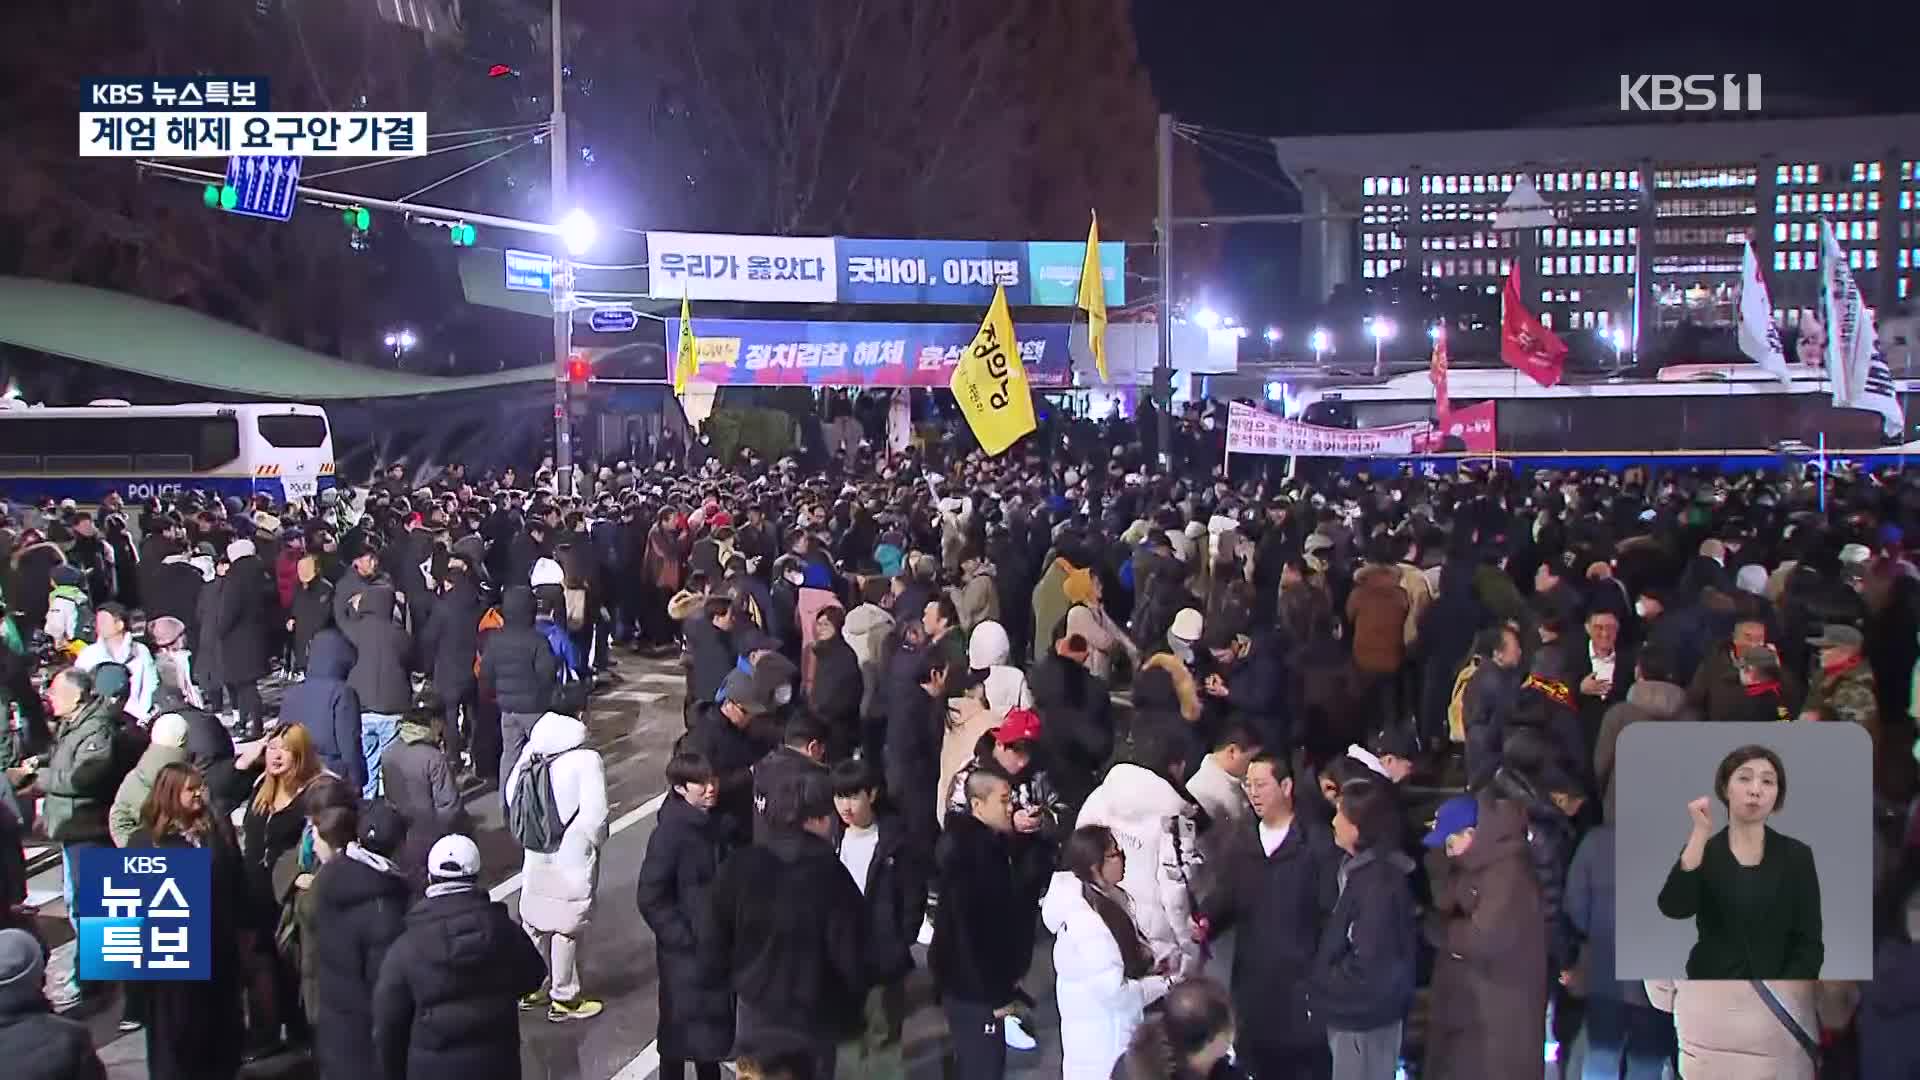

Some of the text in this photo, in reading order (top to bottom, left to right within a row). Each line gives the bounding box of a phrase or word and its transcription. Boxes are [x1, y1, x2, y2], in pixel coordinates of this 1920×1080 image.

[659, 253, 826, 282] 우리가 옳았다
[848, 257, 937, 289] 굿바이,
[943, 260, 1019, 290] 이재명
[745, 343, 849, 370] 정치검찰
[853, 340, 905, 366] 해체
[127, 483, 182, 499] POLICE
